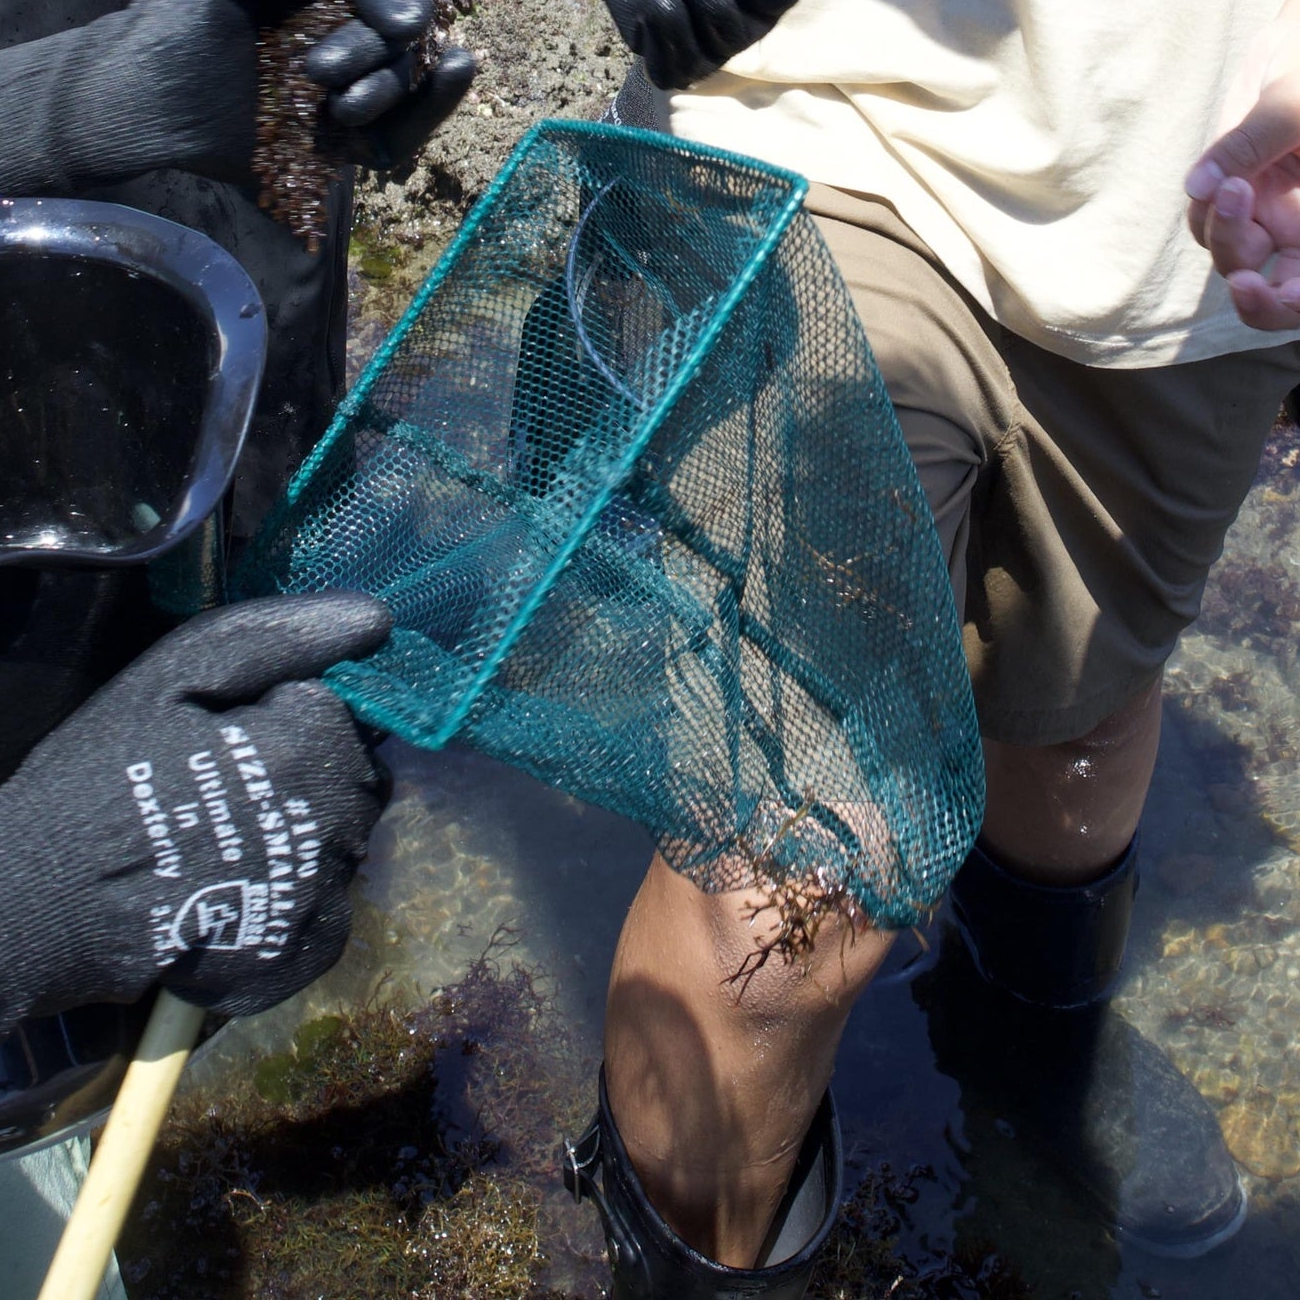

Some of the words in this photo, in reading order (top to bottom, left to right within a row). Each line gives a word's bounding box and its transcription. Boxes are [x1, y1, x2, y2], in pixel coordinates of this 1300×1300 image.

[126, 761, 183, 878] Dexterity
[173, 802, 199, 829] In
[188, 751, 243, 862] Ultimate
